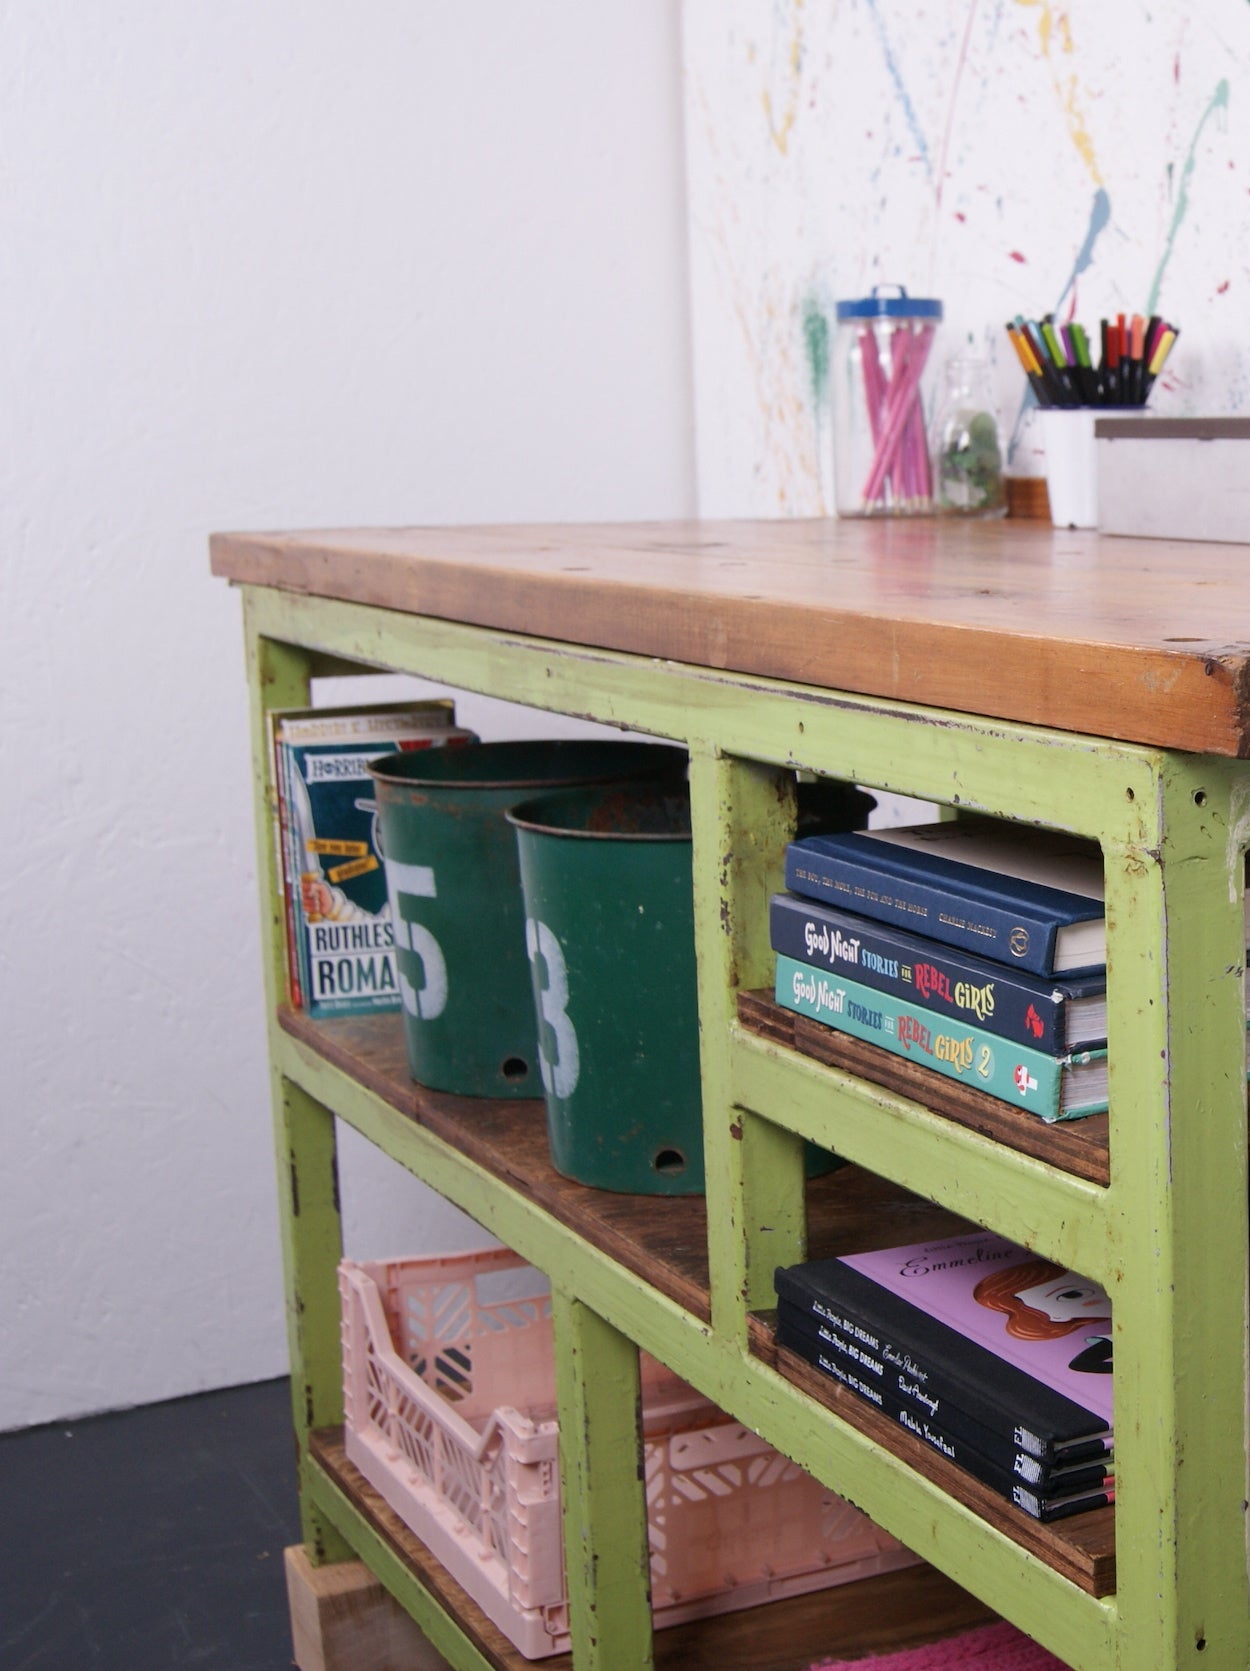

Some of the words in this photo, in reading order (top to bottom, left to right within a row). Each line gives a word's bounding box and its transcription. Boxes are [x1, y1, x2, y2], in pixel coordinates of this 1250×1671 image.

[313, 757, 367, 777] HORRIB
[315, 922, 394, 952] RUTHLES
[384, 857, 448, 1020] 5
[318, 955, 396, 995] ROMA
[861, 949, 899, 978] STORIES
[914, 963, 953, 1003] REBEL
[847, 1000, 883, 1030] STORIES
[898, 1016, 933, 1055] REBEL
[978, 1046, 991, 1078] 2
[900, 1247, 1013, 1277] Emmeline
